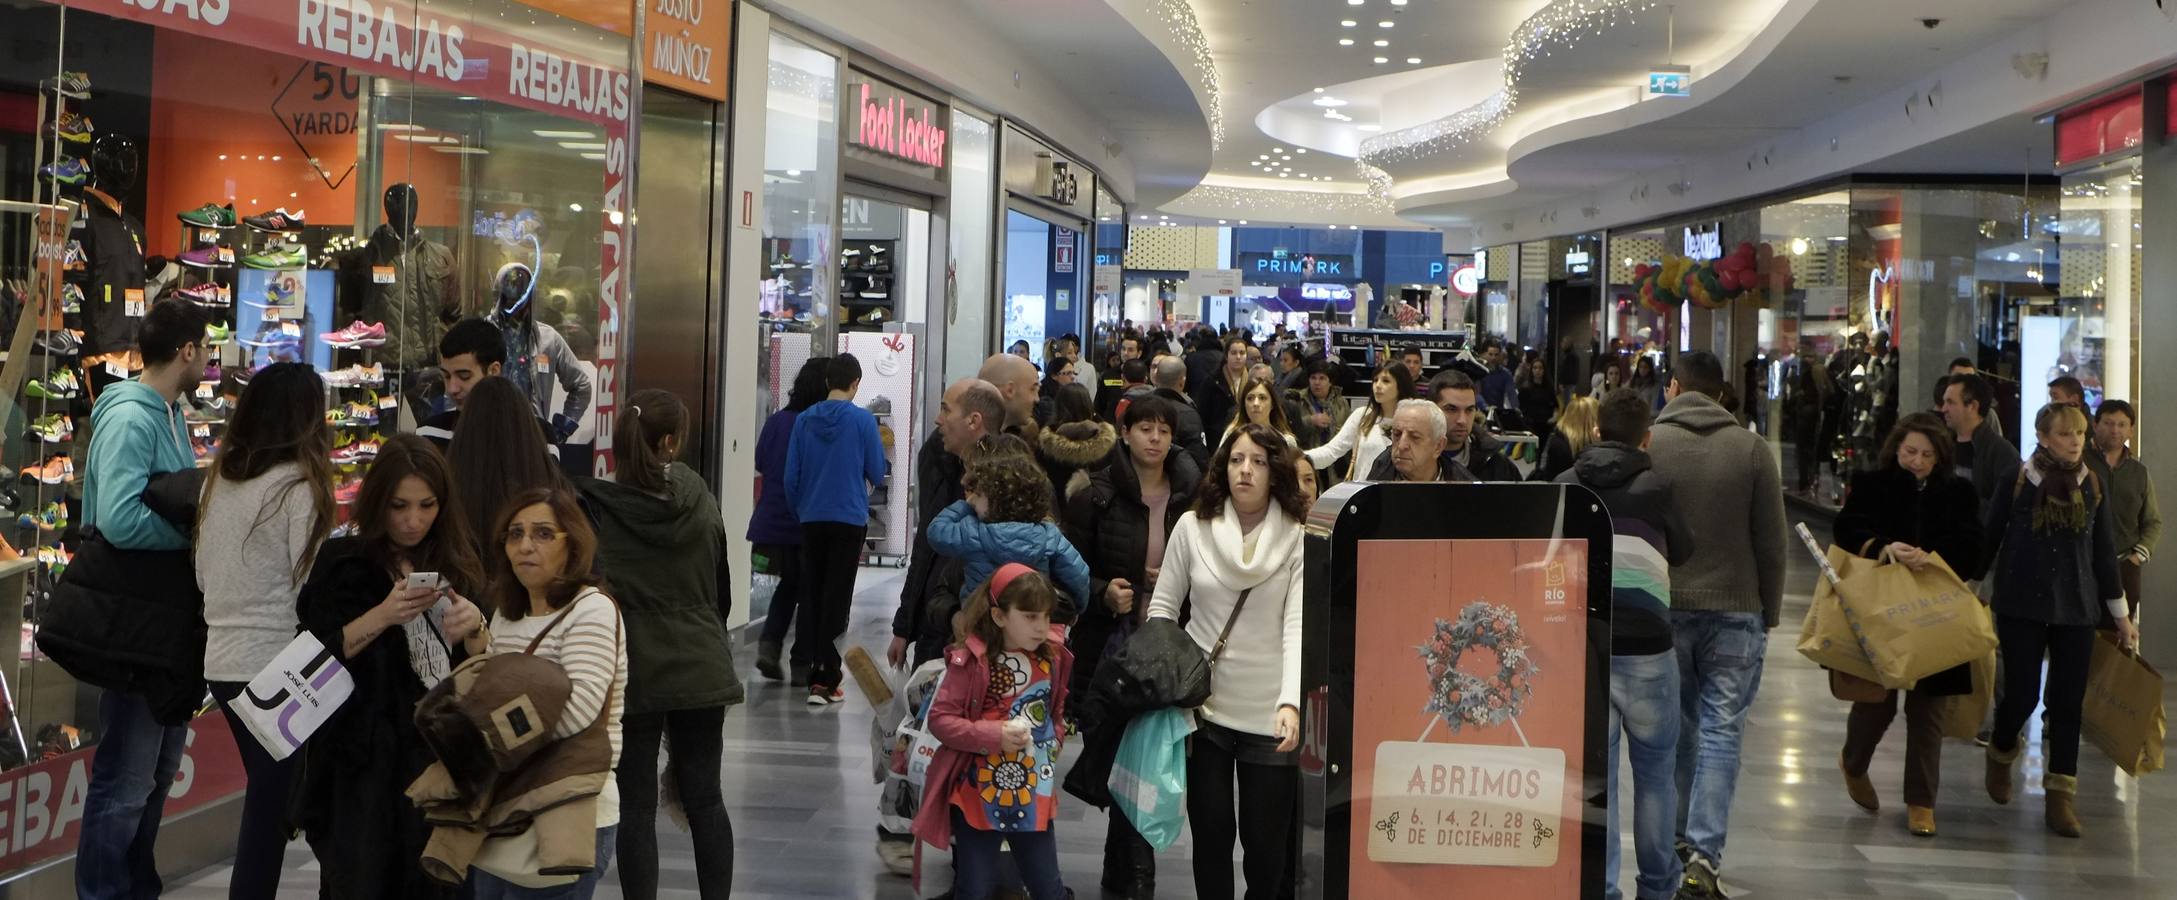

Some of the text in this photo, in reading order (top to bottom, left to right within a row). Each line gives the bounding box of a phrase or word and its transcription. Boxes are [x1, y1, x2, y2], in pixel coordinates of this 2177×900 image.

[298, 0, 465, 81] REBAJAS
[653, 29, 712, 84] MUÑOZ
[509, 43, 629, 121] REBAJAS
[860, 83, 945, 168] Foot Locker
[39, 221, 66, 236] addas
[1257, 259, 1341, 275] PRIMRK
[1544, 587, 1566, 600] RÍO
[283, 669, 321, 709] JOSÉ LUIS
[1406, 764, 1541, 799] ABRIMOS
[1504, 811, 1523, 828] 28
[1407, 828, 1522, 848] DE DICIEMBRE
